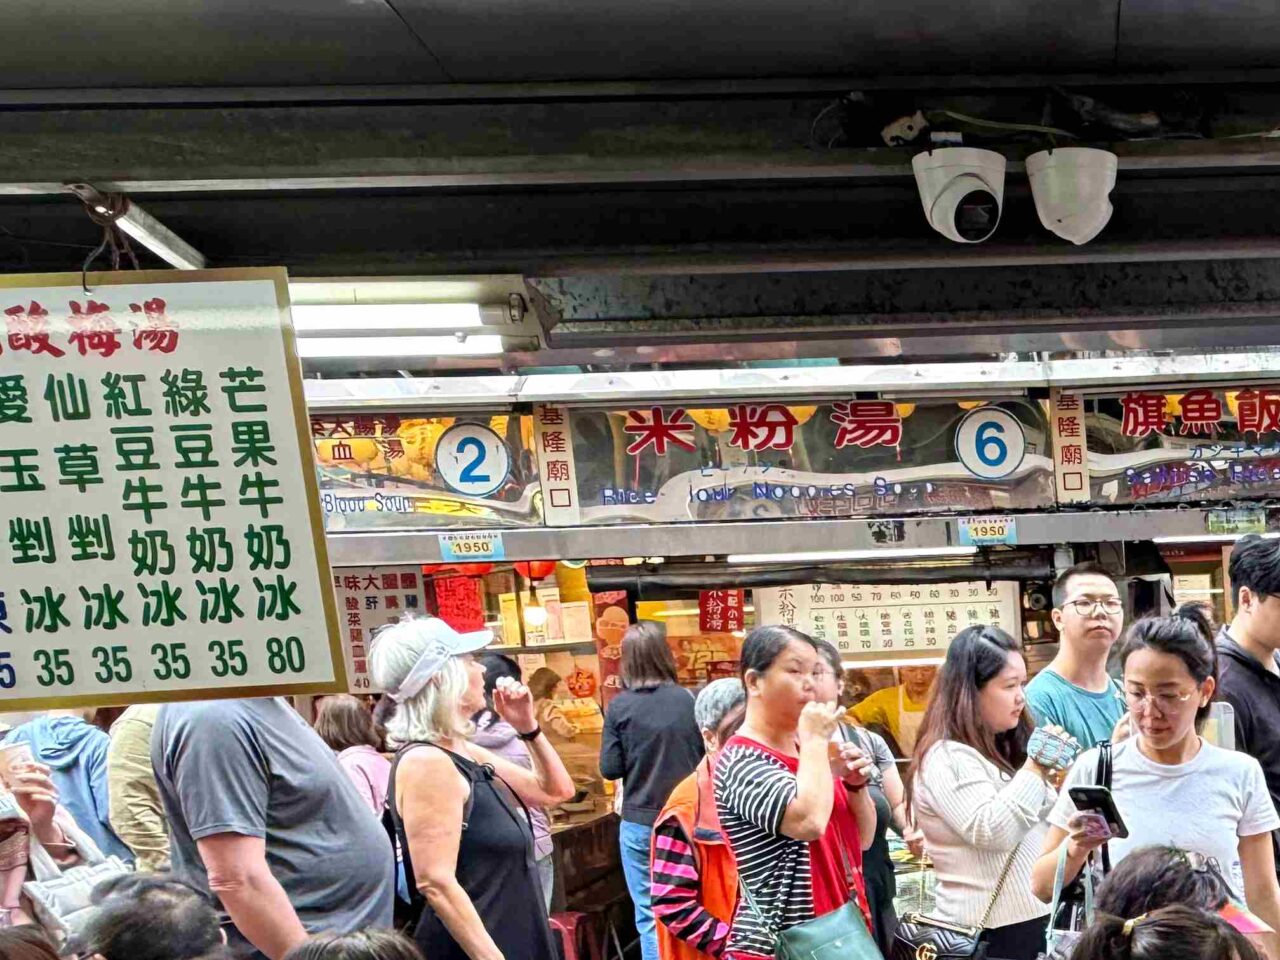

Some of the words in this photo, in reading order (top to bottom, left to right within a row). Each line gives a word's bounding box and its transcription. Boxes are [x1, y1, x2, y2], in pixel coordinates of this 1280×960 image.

[0, 298, 181, 358] 酸梅湯
[624, 400, 902, 455] 米粉湯
[974, 421, 1008, 467] 6
[1056, 394, 1083, 491] 基隆廟口
[456, 436, 491, 483] 2
[539, 403, 572, 508] 基隆廟口
[100, 371, 187, 627] 紅豆牛奶冰
[151, 642, 191, 679] 35
[160, 367, 247, 625] 綠豆牛奶冰
[207, 639, 248, 677] 35
[219, 365, 302, 622] 芒果牛奶冰
[266, 636, 306, 675] 80
[455, 541, 490, 554] 1950
[972, 525, 1006, 537] 1950
[33, 648, 75, 687] 35
[92, 645, 133, 683] 35
